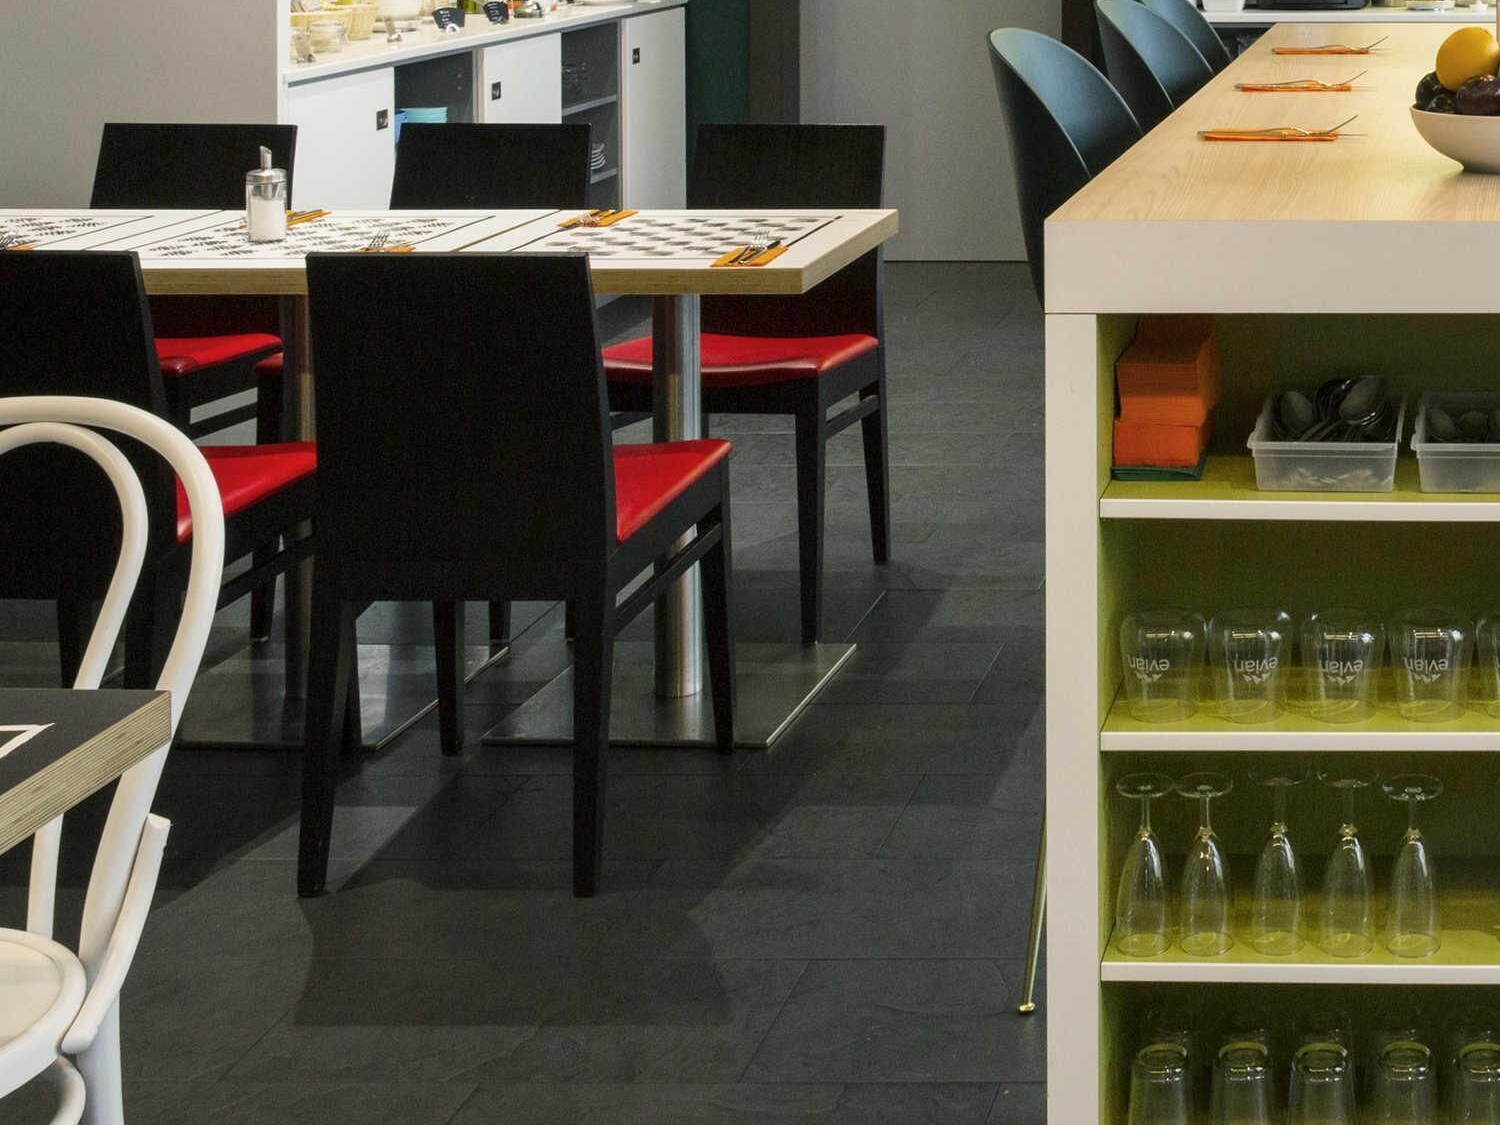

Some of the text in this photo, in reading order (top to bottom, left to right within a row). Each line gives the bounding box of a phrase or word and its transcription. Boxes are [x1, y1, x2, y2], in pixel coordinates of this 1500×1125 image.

[1128, 656, 1171, 672] evian
[1234, 655, 1279, 674] evian
[1321, 658, 1365, 675] evian
[1403, 656, 1449, 673] evian
